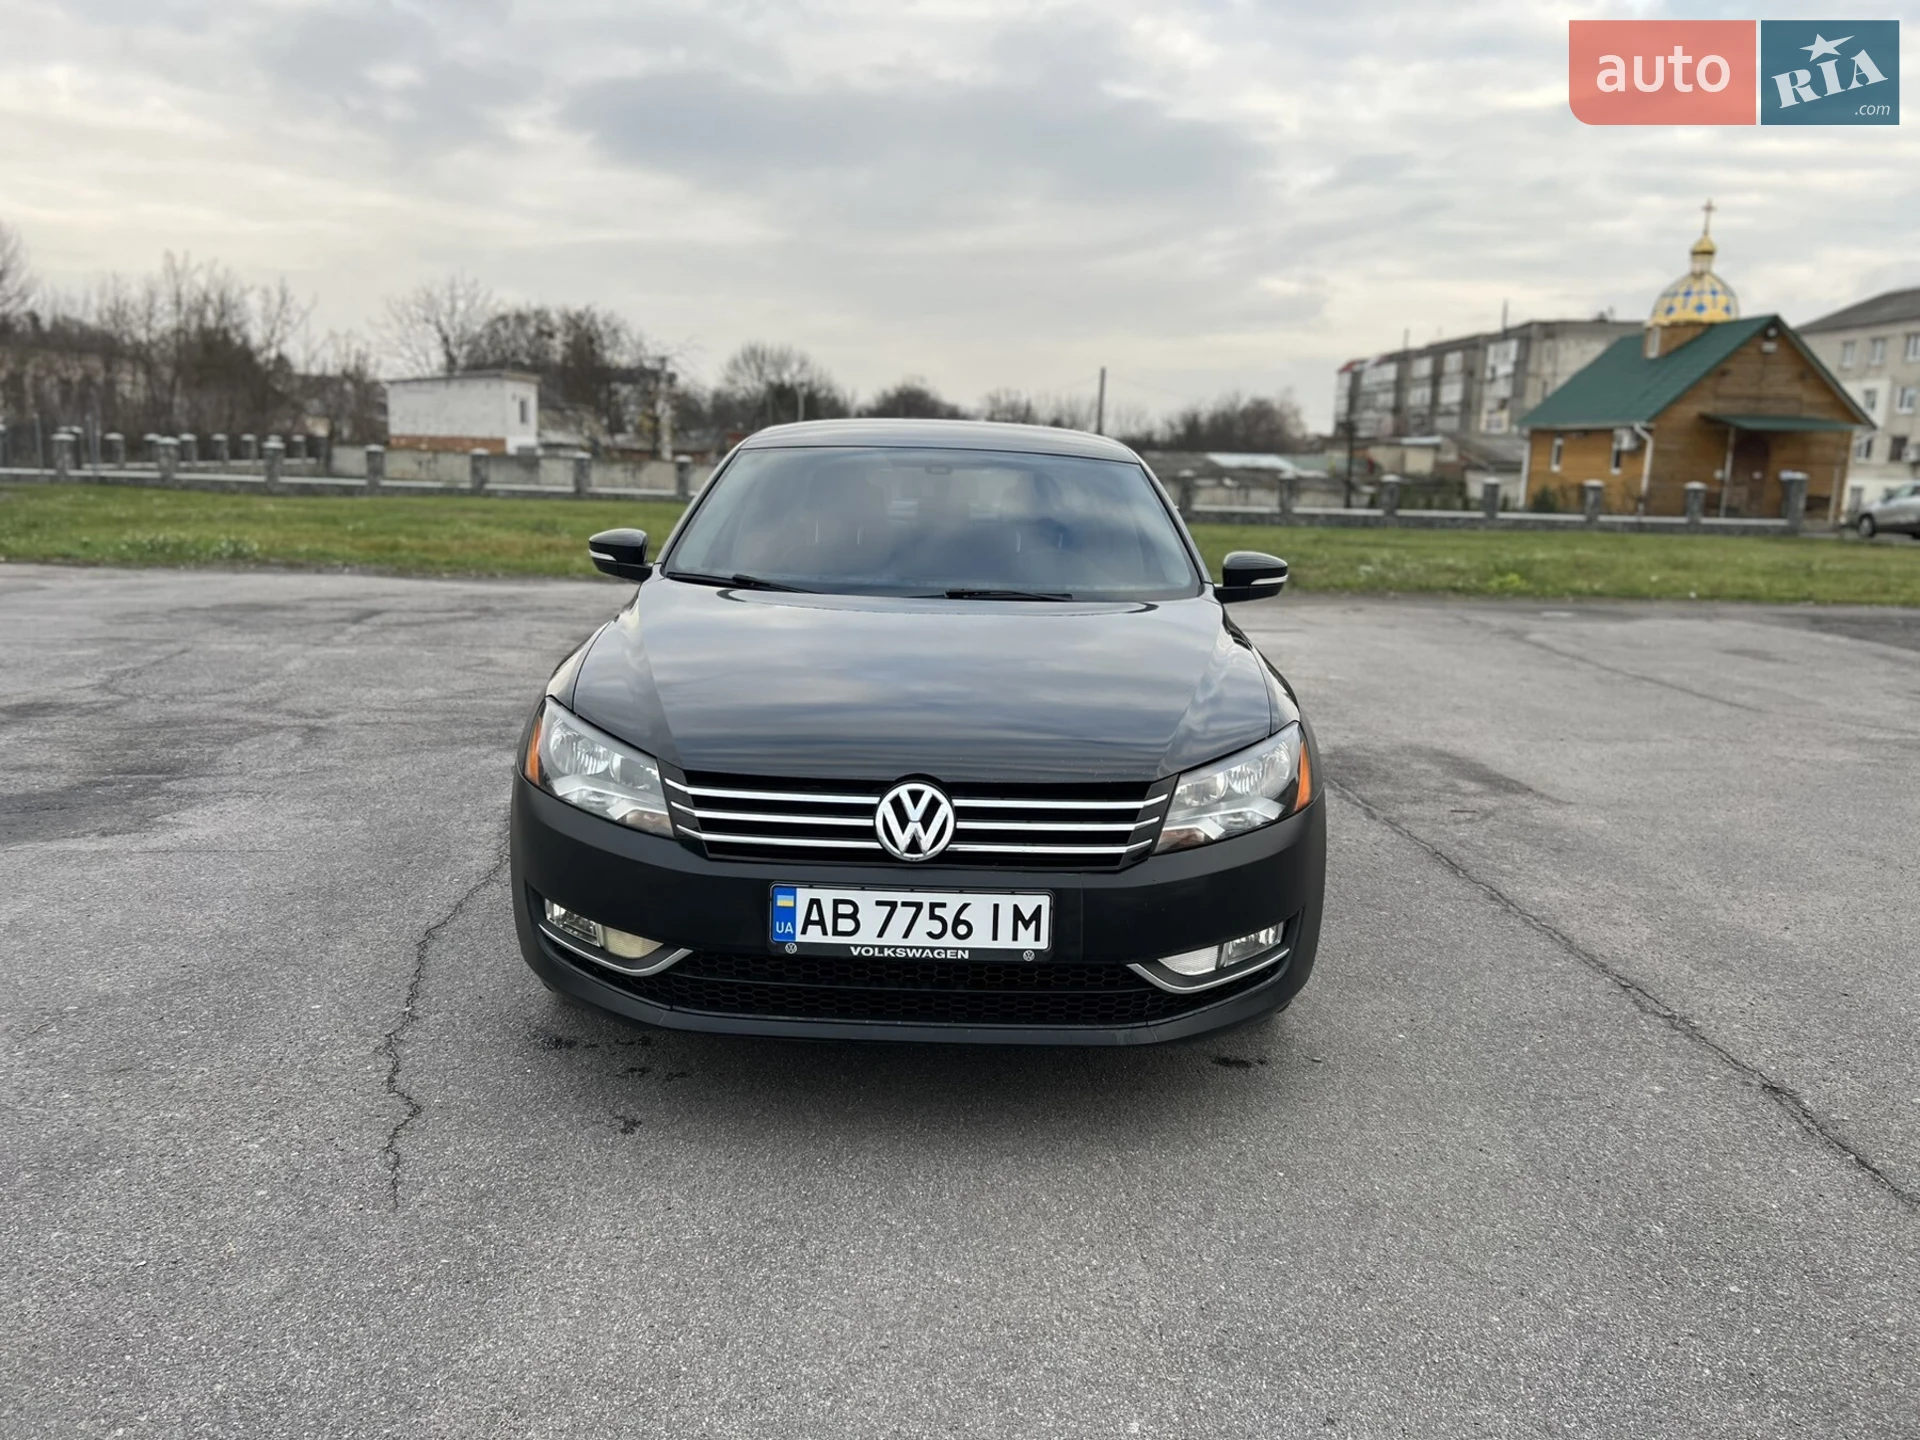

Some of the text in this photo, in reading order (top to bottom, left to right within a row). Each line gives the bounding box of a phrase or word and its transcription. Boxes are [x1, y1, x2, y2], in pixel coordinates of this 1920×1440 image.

[800, 897, 1042, 943] AB 7756 IM
[775, 921, 794, 935] UA
[849, 946, 970, 960] VOLKSWAGEN
